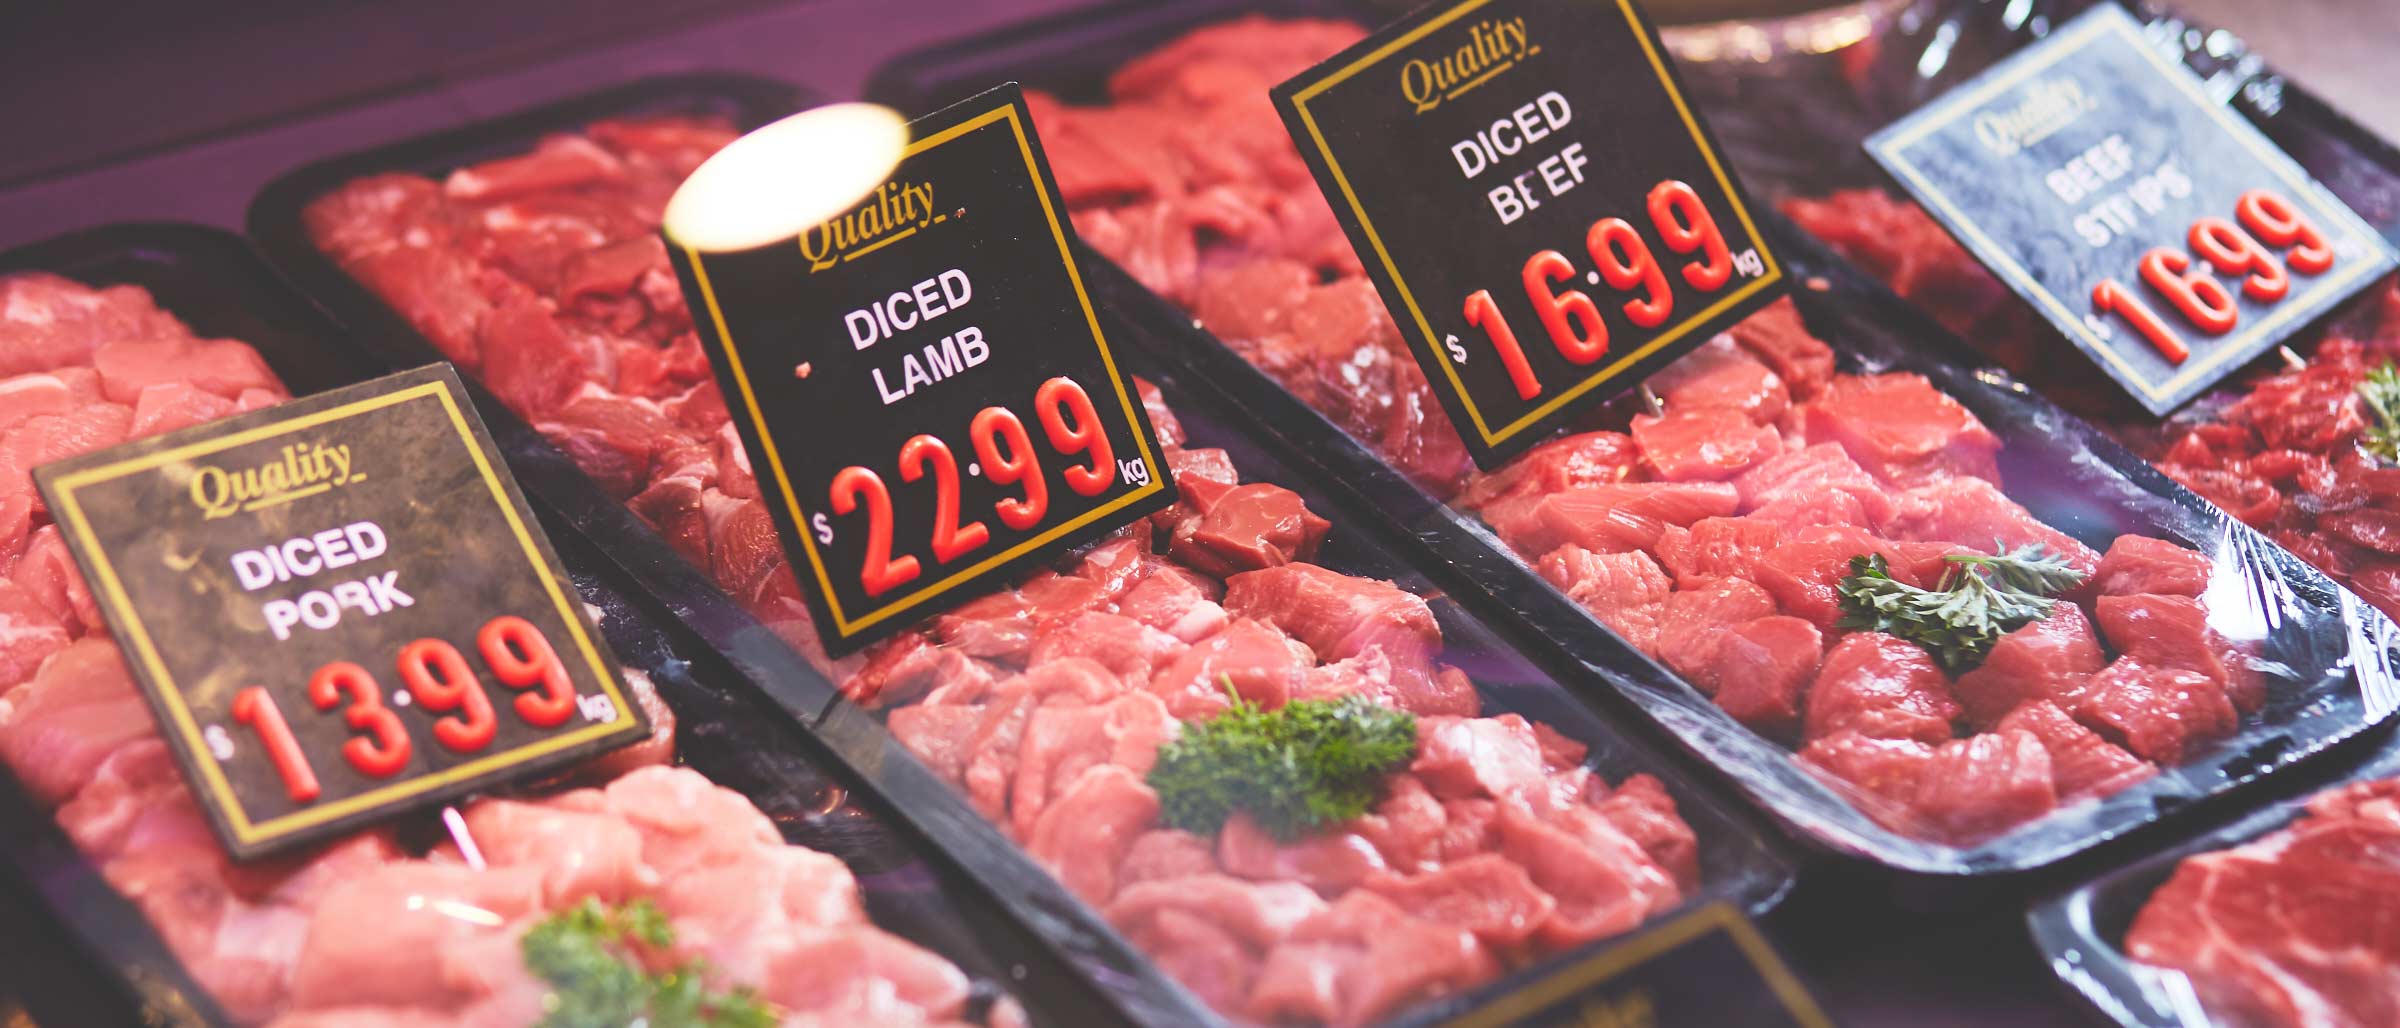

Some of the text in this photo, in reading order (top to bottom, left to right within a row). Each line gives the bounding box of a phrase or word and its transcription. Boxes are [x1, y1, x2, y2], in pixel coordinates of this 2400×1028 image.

[1400, 16, 1529, 115] Quality
[1451, 91, 1572, 179] DICED
[1488, 142, 1588, 225] BEEF
[799, 181, 935, 273] Quality
[844, 268, 972, 350] DICED
[1445, 334, 1468, 364] $
[1730, 248, 1764, 278] kg
[872, 326, 990, 405] LAMB
[191, 441, 353, 520] Quality
[813, 512, 834, 545] $
[1117, 457, 1150, 487] kg
[230, 521, 388, 591] DICED
[262, 570, 416, 641] PORK
